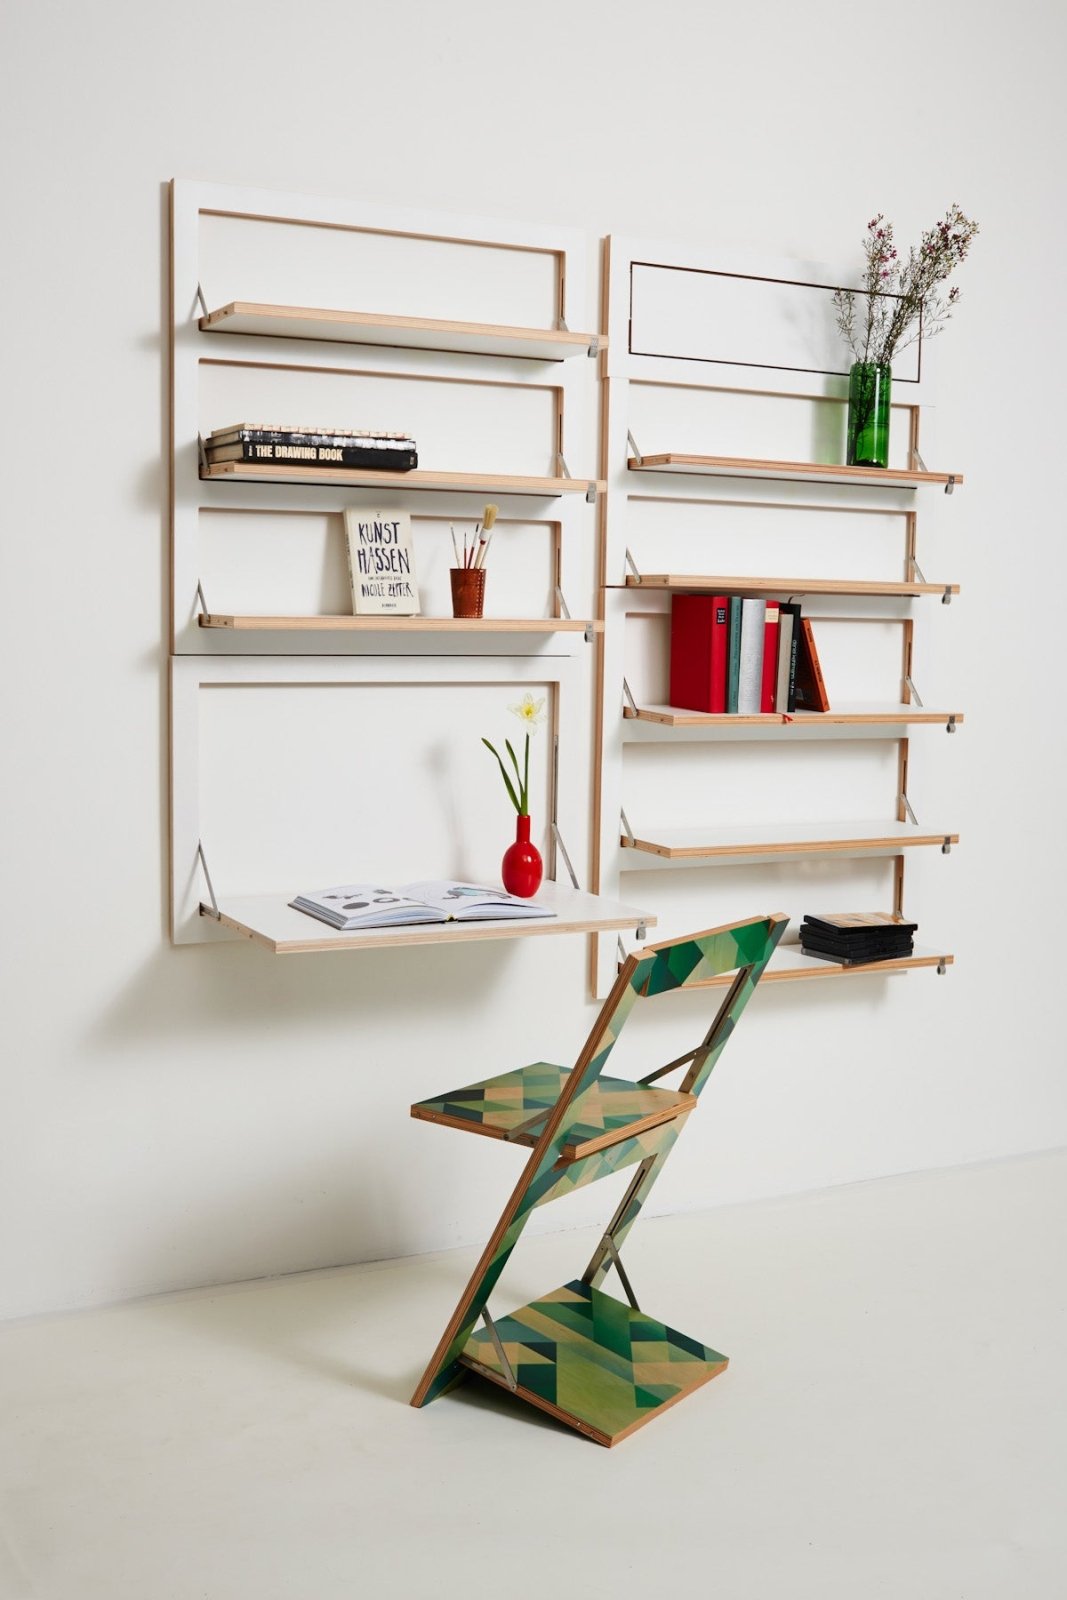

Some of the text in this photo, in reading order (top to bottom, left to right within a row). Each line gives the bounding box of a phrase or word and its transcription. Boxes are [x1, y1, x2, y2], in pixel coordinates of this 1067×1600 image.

[255, 445, 273, 458] THE
[274, 446, 317, 460] DRAWING
[318, 448, 343, 461] BOOK
[358, 521, 400, 545] KUNST
[357, 546, 410, 574] HASSEN
